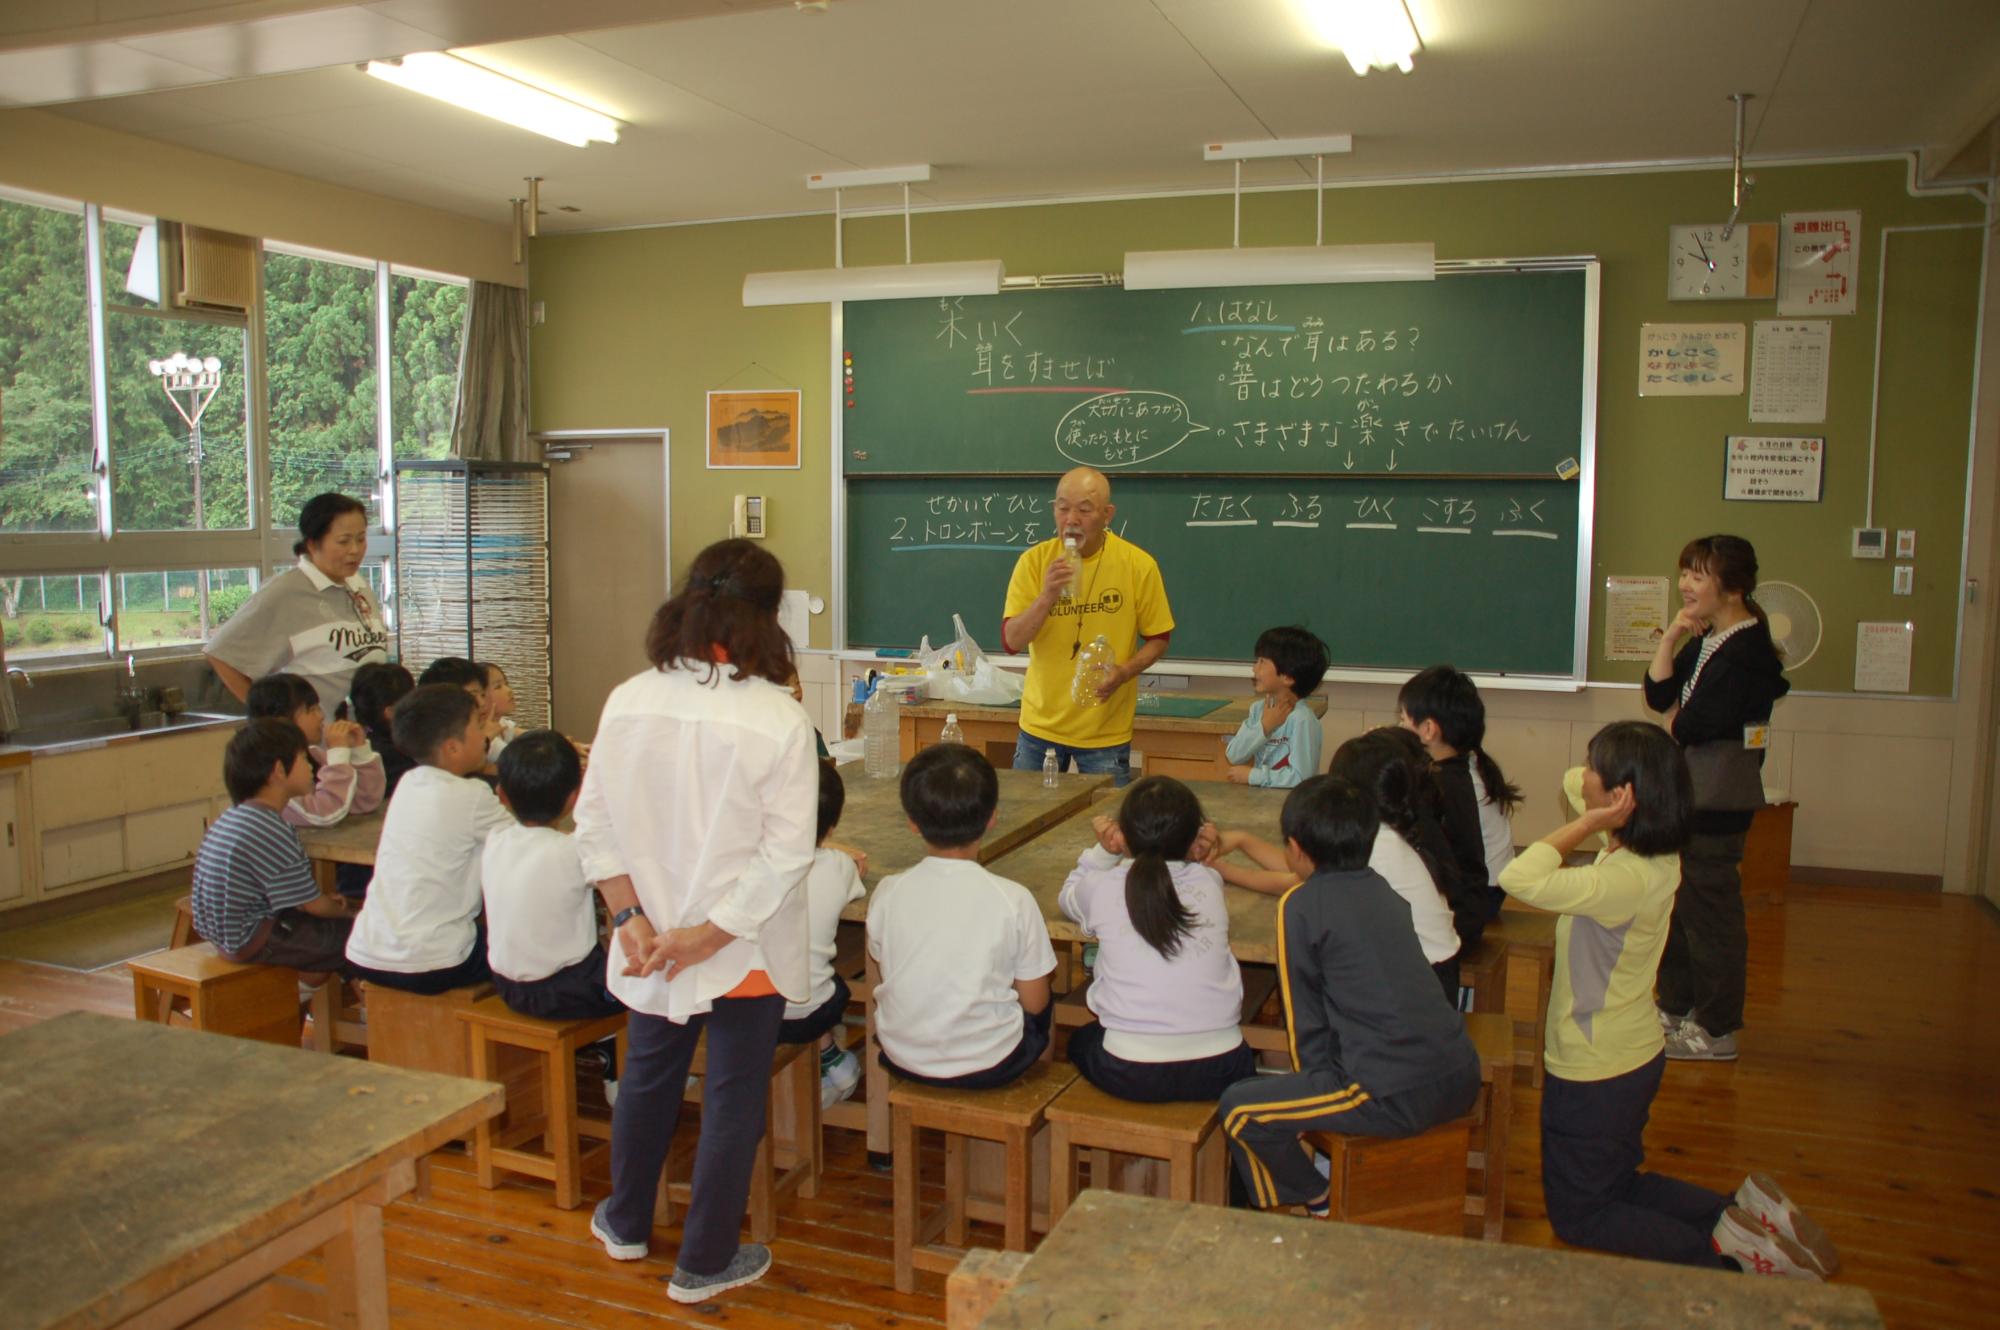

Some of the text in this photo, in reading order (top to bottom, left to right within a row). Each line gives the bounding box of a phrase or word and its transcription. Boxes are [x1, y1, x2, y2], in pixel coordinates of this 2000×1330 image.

[1703, 231, 1713, 241] 12
[1676, 257, 1685, 267] 9
[1732, 256, 1740, 268] 3
[1703, 282, 1711, 294] 6
[1647, 347, 1717, 357] かしこく
[971, 351, 1117, 387] 耳をすませば
[1229, 372, 1453, 401] 音はどうつたわるか
[926, 492, 1056, 515] せかいでひと
[1191, 493, 1544, 525] たたく ふる ひく こする ふく
[1685, 1036, 1709, 1054] N
